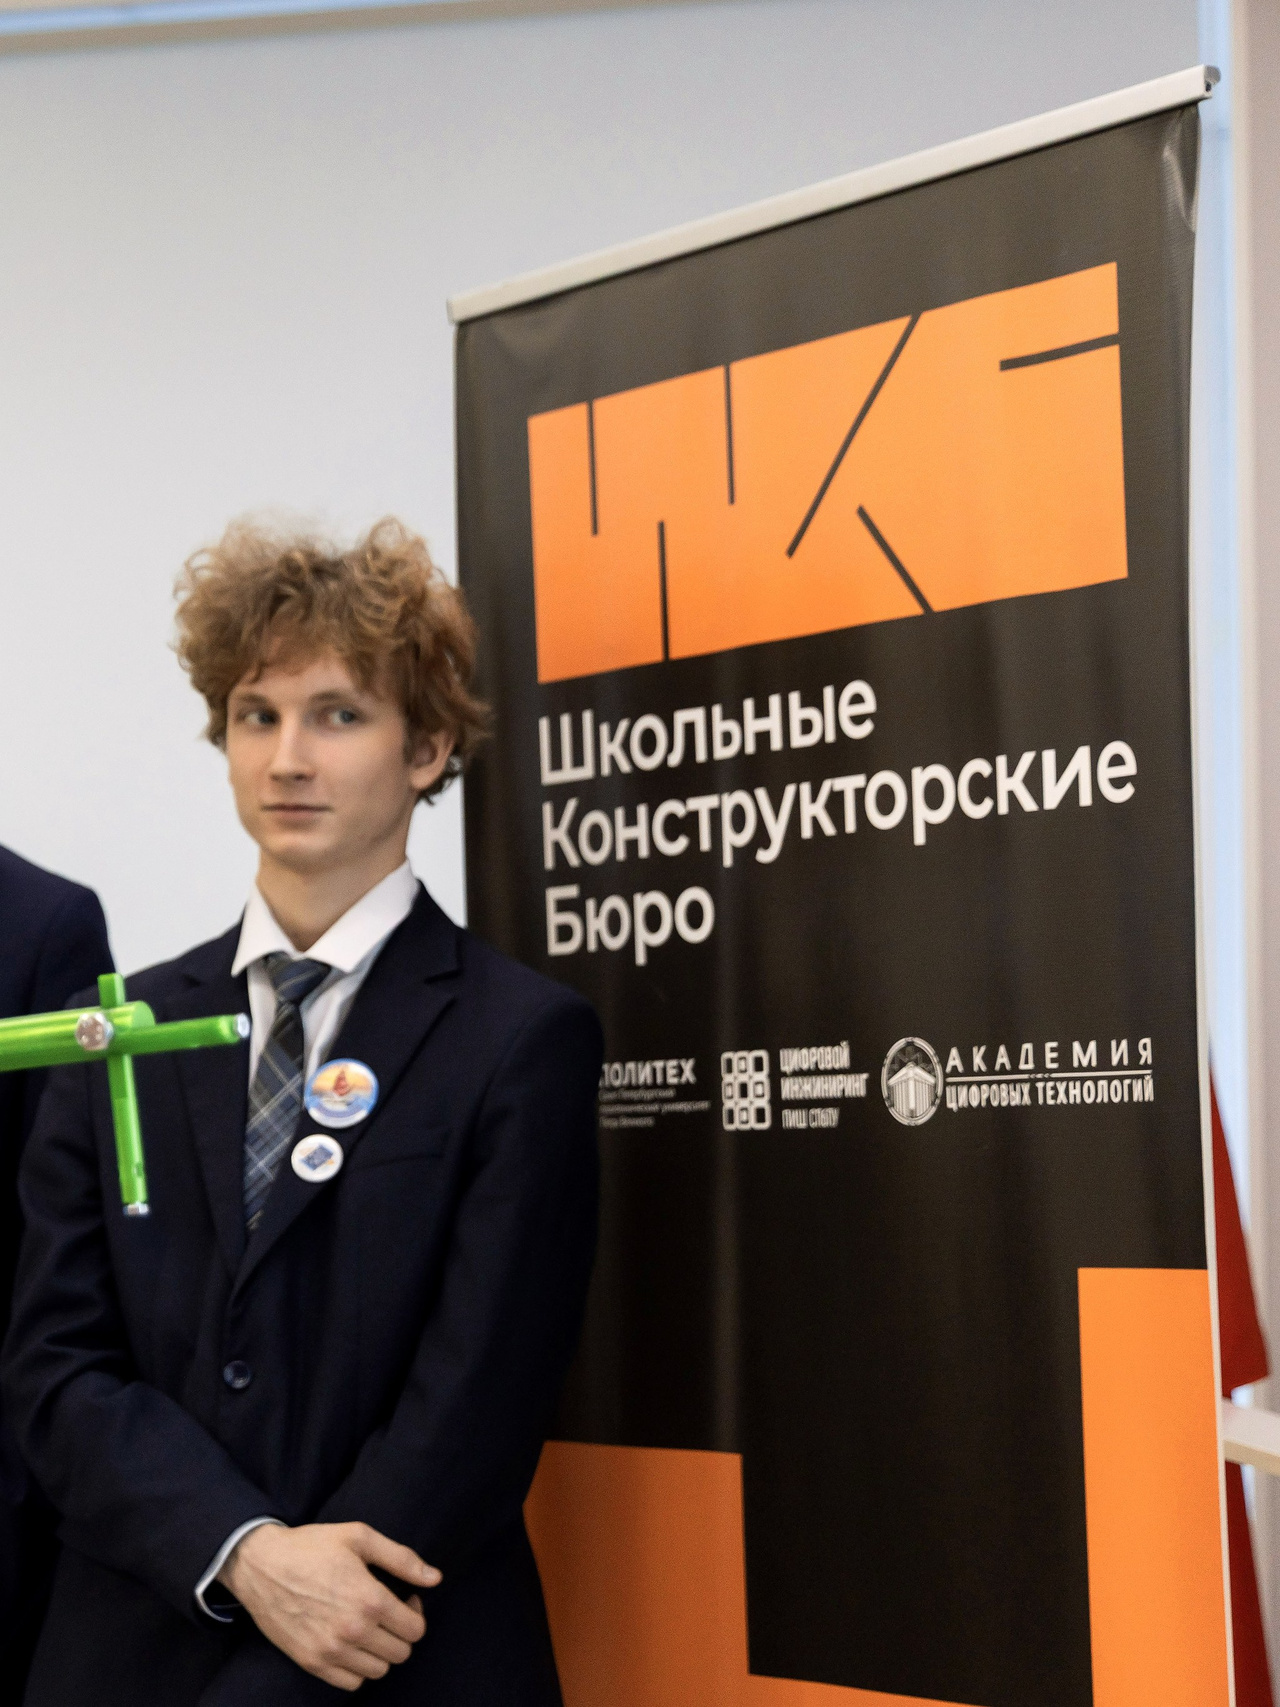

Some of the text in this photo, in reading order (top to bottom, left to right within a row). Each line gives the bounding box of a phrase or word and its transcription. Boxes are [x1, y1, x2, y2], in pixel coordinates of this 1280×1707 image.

[539, 679, 877, 786] Школьные
[542, 740, 1138, 869] Конструкторские
[544, 885, 715, 966] Бюро
[780, 1040, 850, 1075] ЦИФРОВОЙ
[945, 1037, 1153, 1073] АКАДЕМИЯ
[781, 1072, 868, 1100] ИНЖИНИРИНГ
[945, 1075, 1154, 1112] ЦИФРОВЫХ ТЕХНОЛОГИЙ
